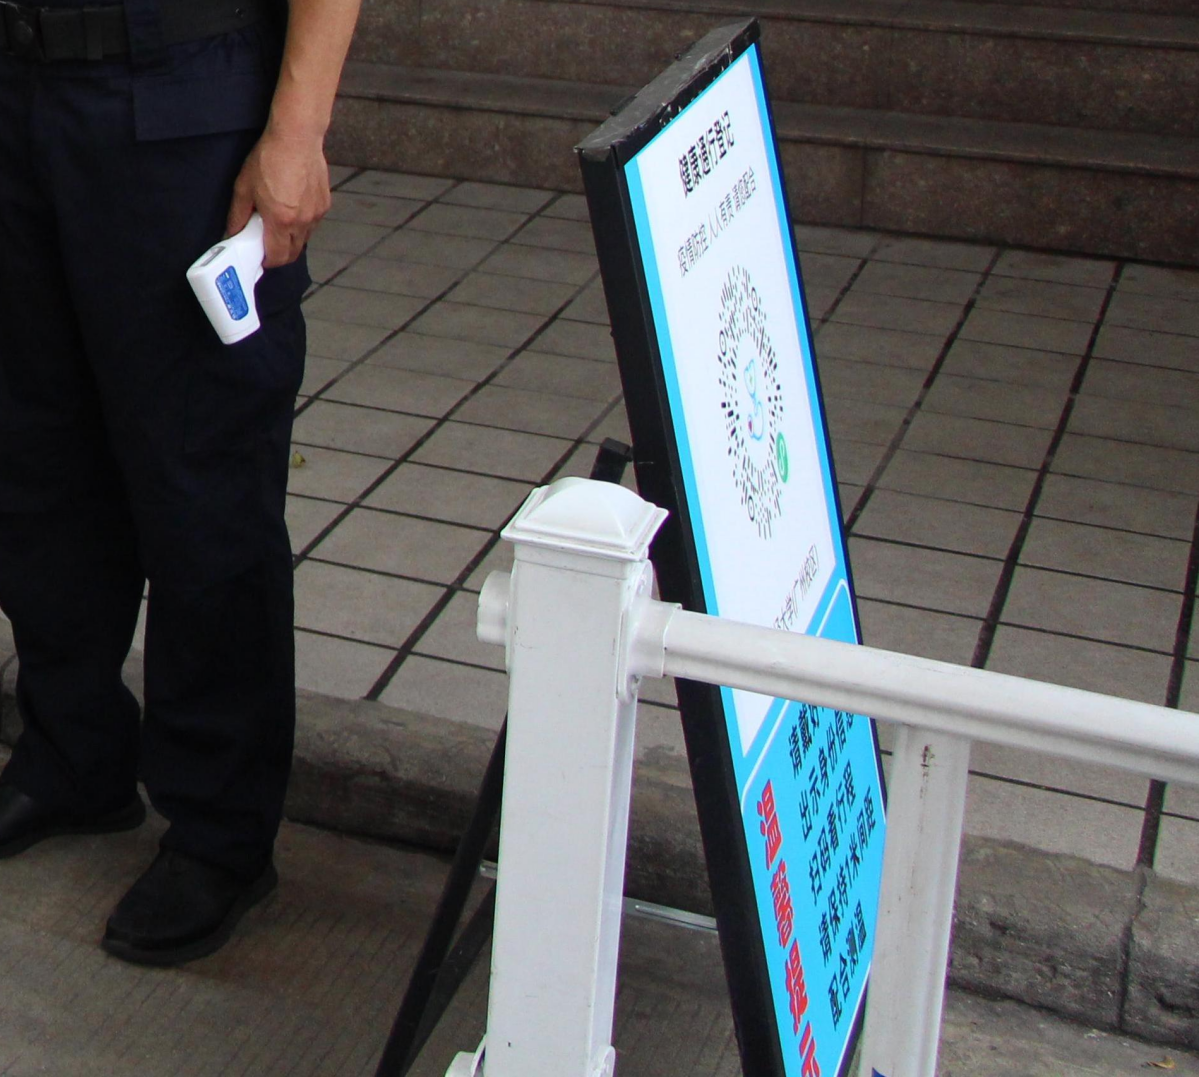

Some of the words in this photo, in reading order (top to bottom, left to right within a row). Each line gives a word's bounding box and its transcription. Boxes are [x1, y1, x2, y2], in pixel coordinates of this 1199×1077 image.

[678, 110, 735, 198] 健康通行登记
[677, 222, 709, 277] 疫情防控
[788, 703, 825, 780] 请戴好
[809, 759, 856, 906] 扫码看行程
[818, 785, 876, 968] 请保持1米间距
[828, 898, 867, 1032] 配合测温
